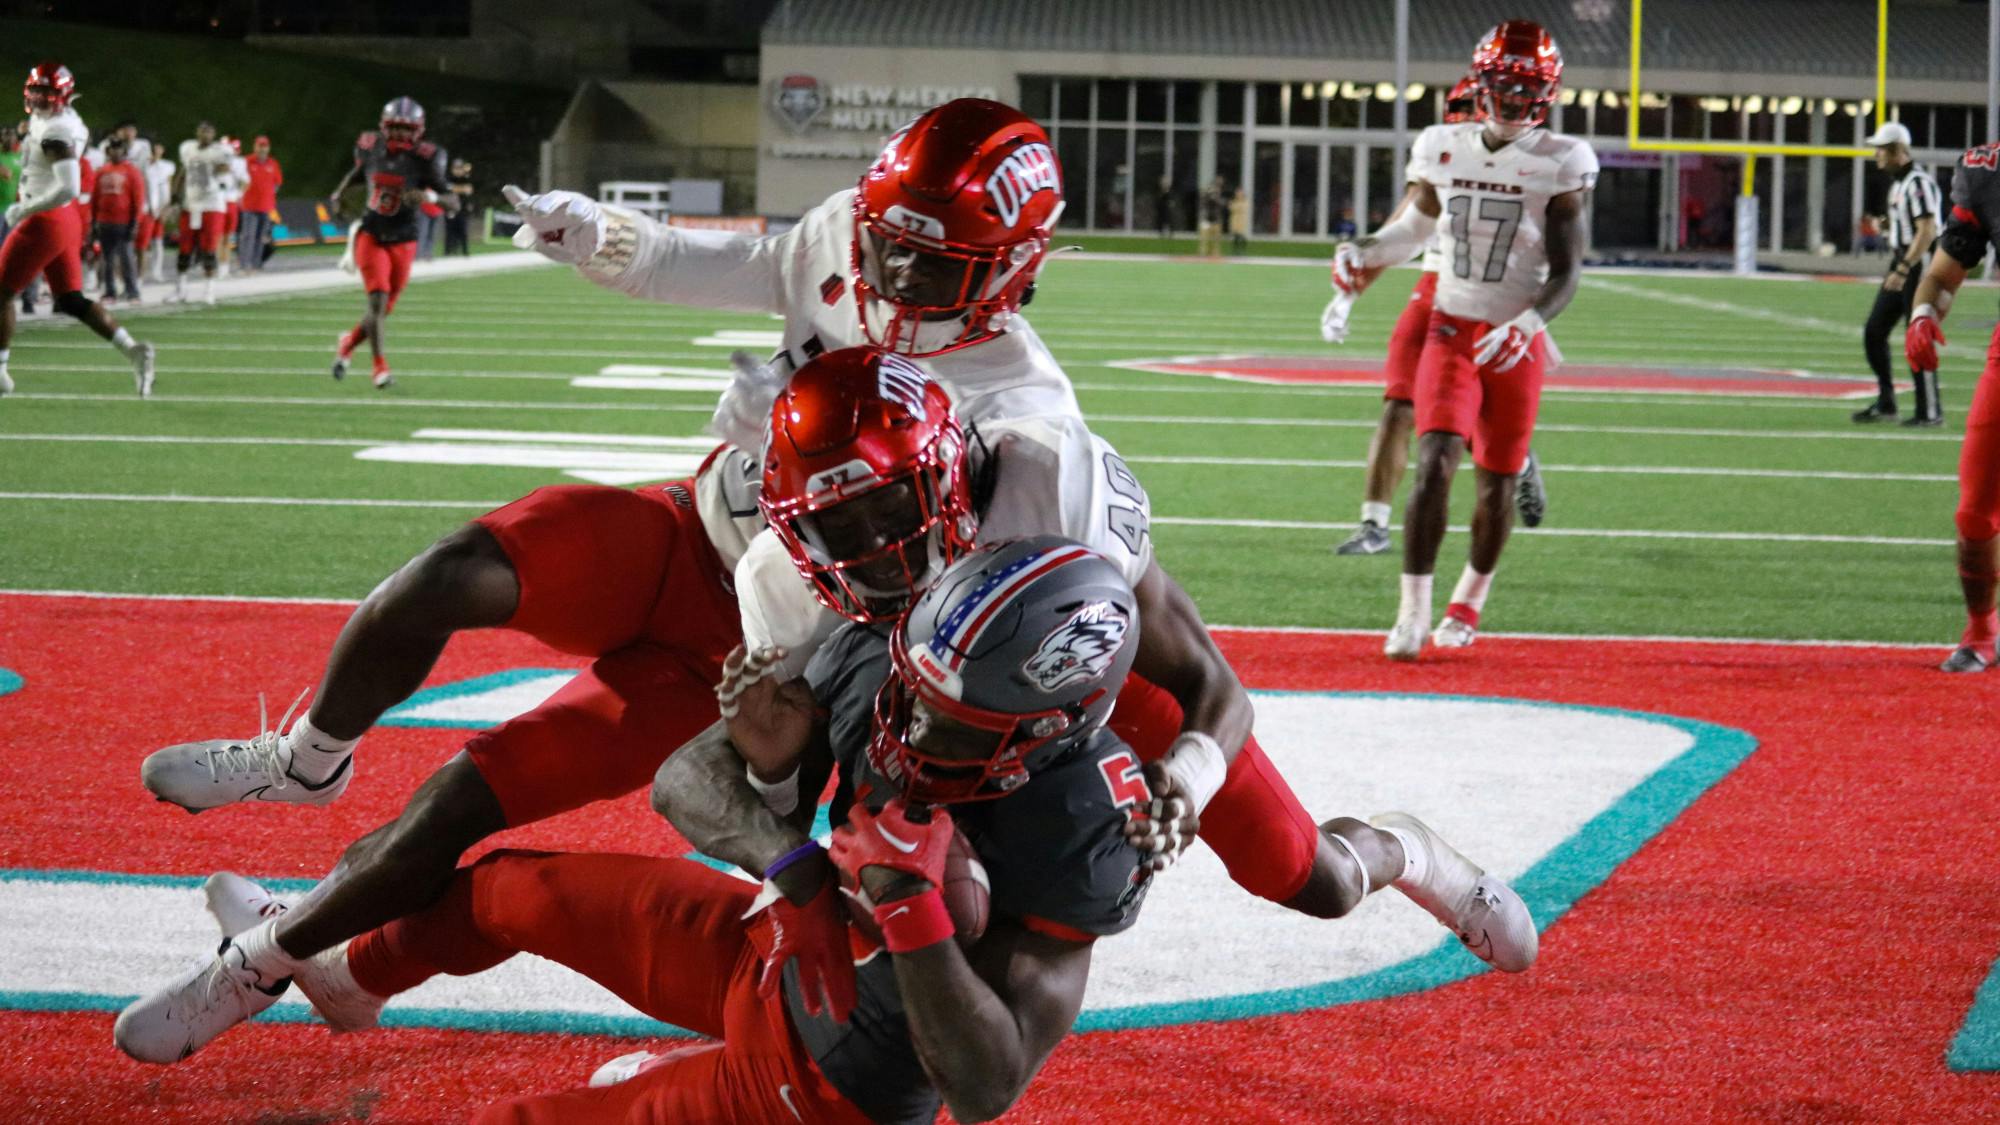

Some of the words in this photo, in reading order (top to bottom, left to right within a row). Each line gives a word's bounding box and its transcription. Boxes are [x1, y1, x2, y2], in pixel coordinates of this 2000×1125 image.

[831, 87, 893, 105] NEW
[832, 111, 915, 130] MUTU
[1452, 178, 1522, 194] REBELS
[1447, 195, 1522, 282] 17
